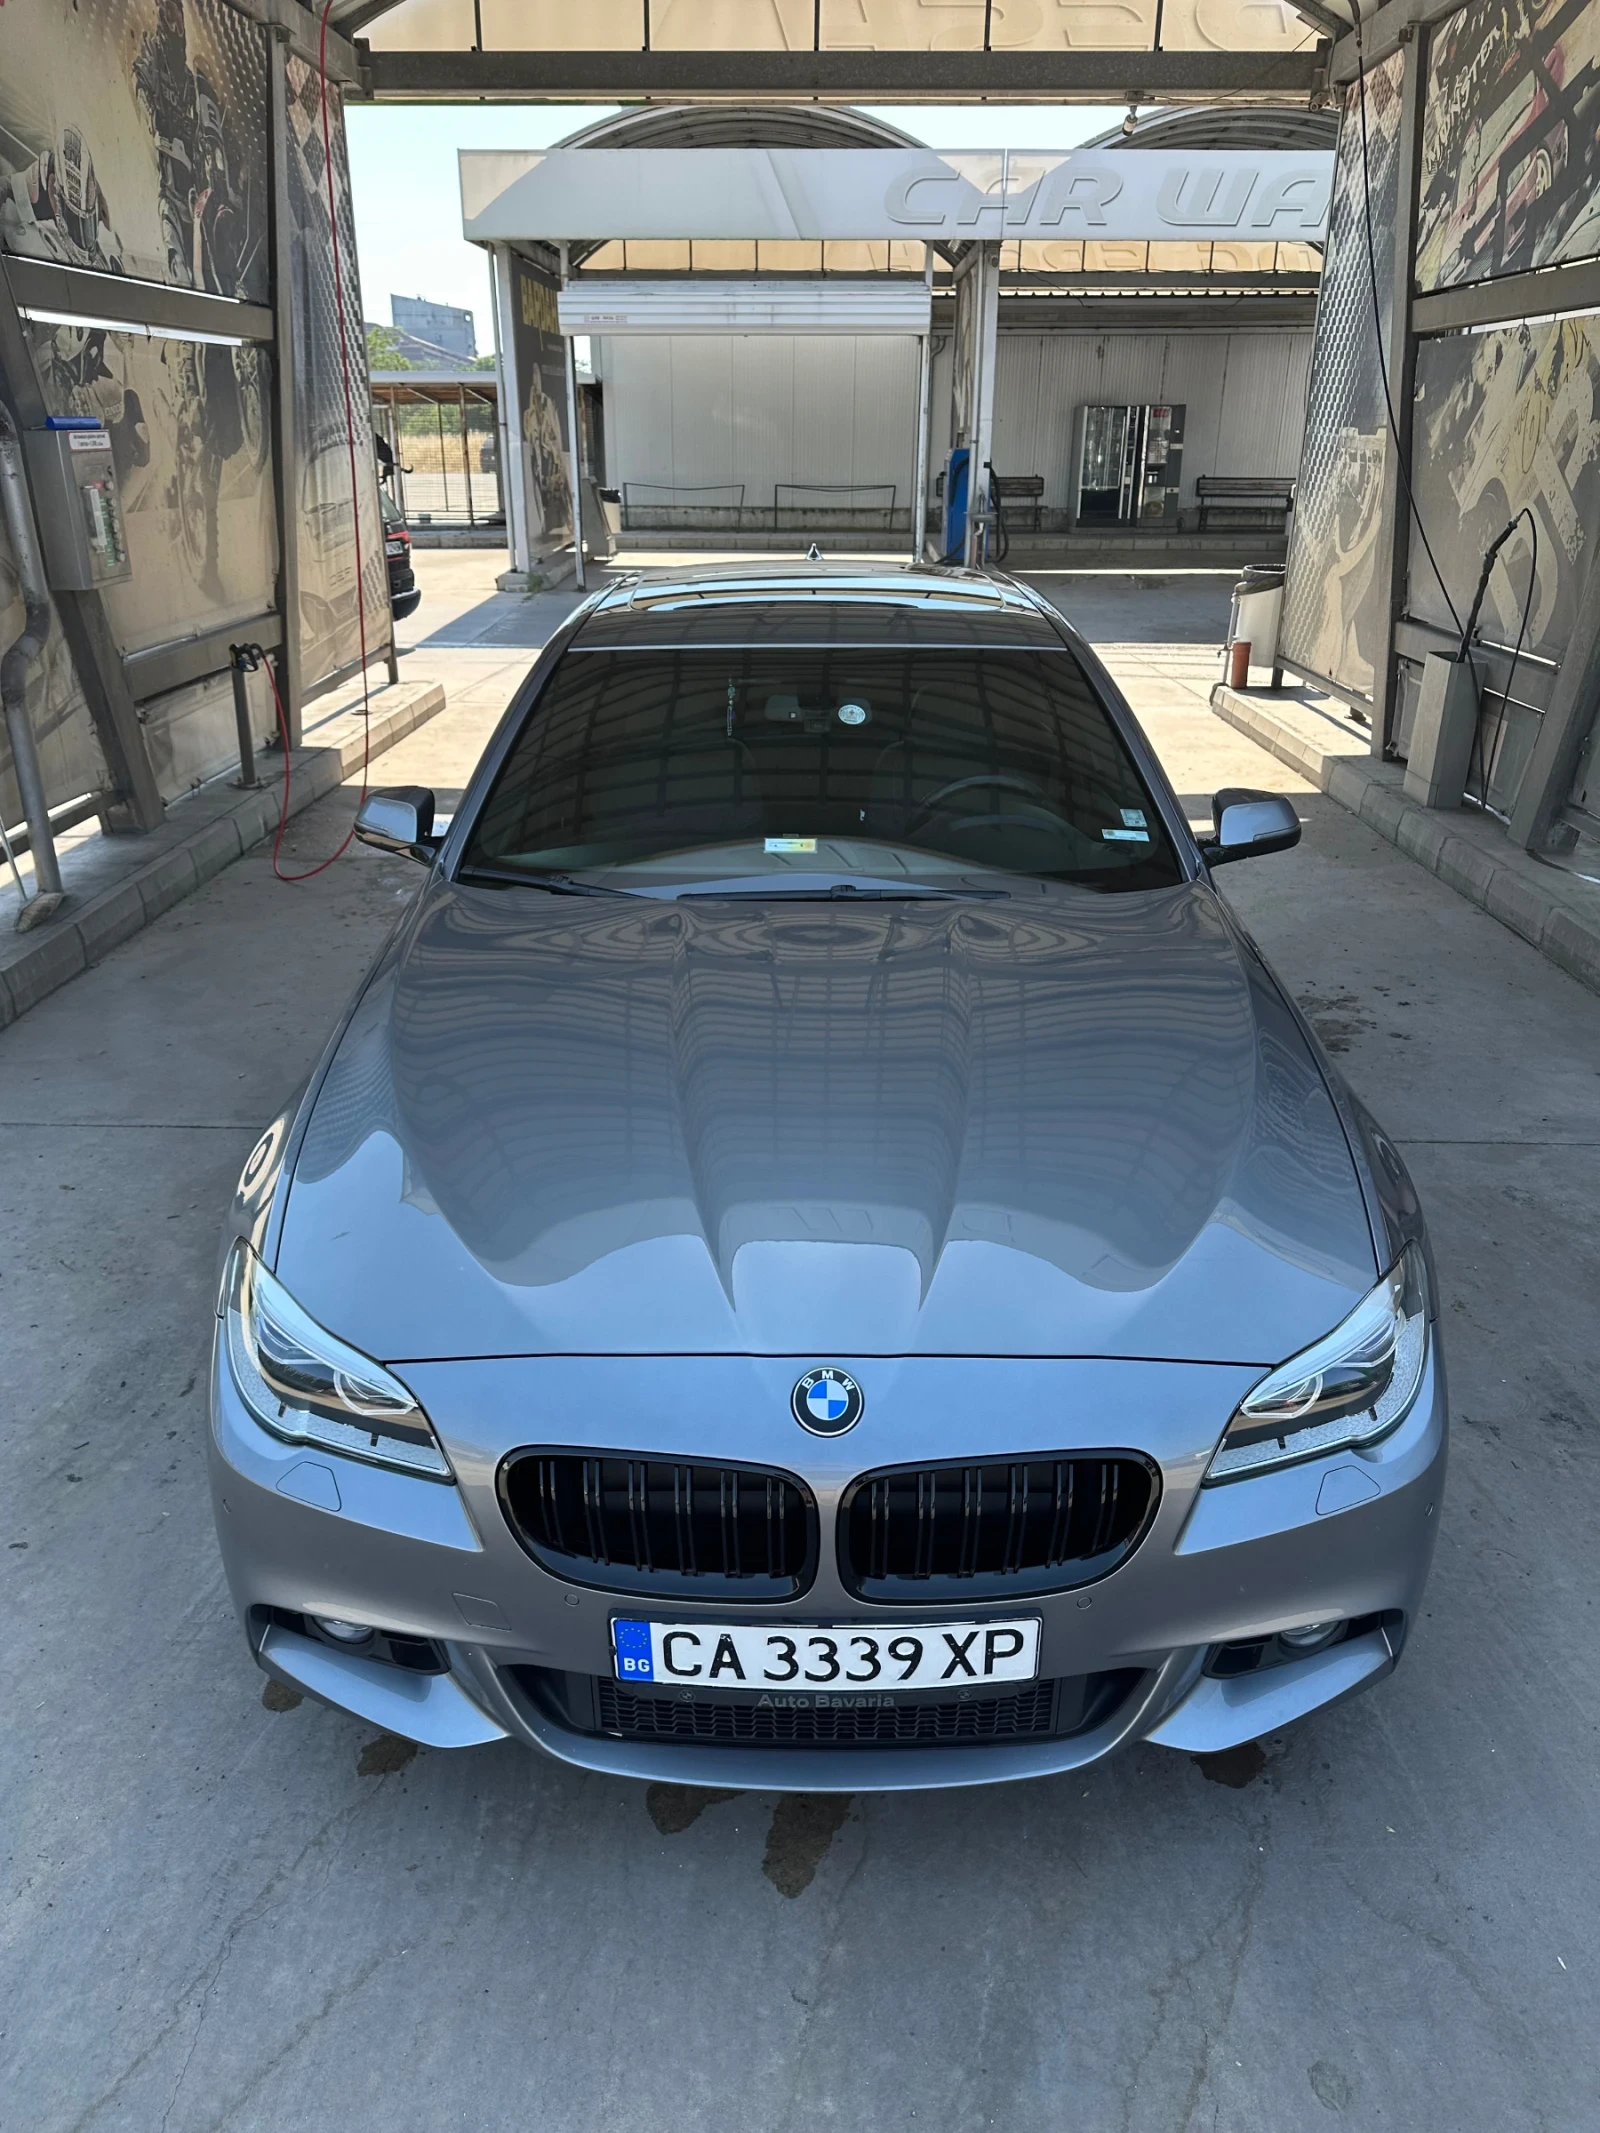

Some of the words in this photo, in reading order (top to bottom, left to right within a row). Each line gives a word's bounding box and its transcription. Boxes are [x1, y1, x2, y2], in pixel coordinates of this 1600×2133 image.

[884, 166, 1124, 225] CAR
[801, 1370, 855, 1391] BMW
[623, 1657, 650, 1673] BG
[662, 1631, 746, 1680] CA
[763, 1635, 924, 1682] 3339
[940, 1628, 1024, 1680] XP
[757, 1693, 809, 1708] Auto
[815, 1693, 895, 1708] Bavaria
